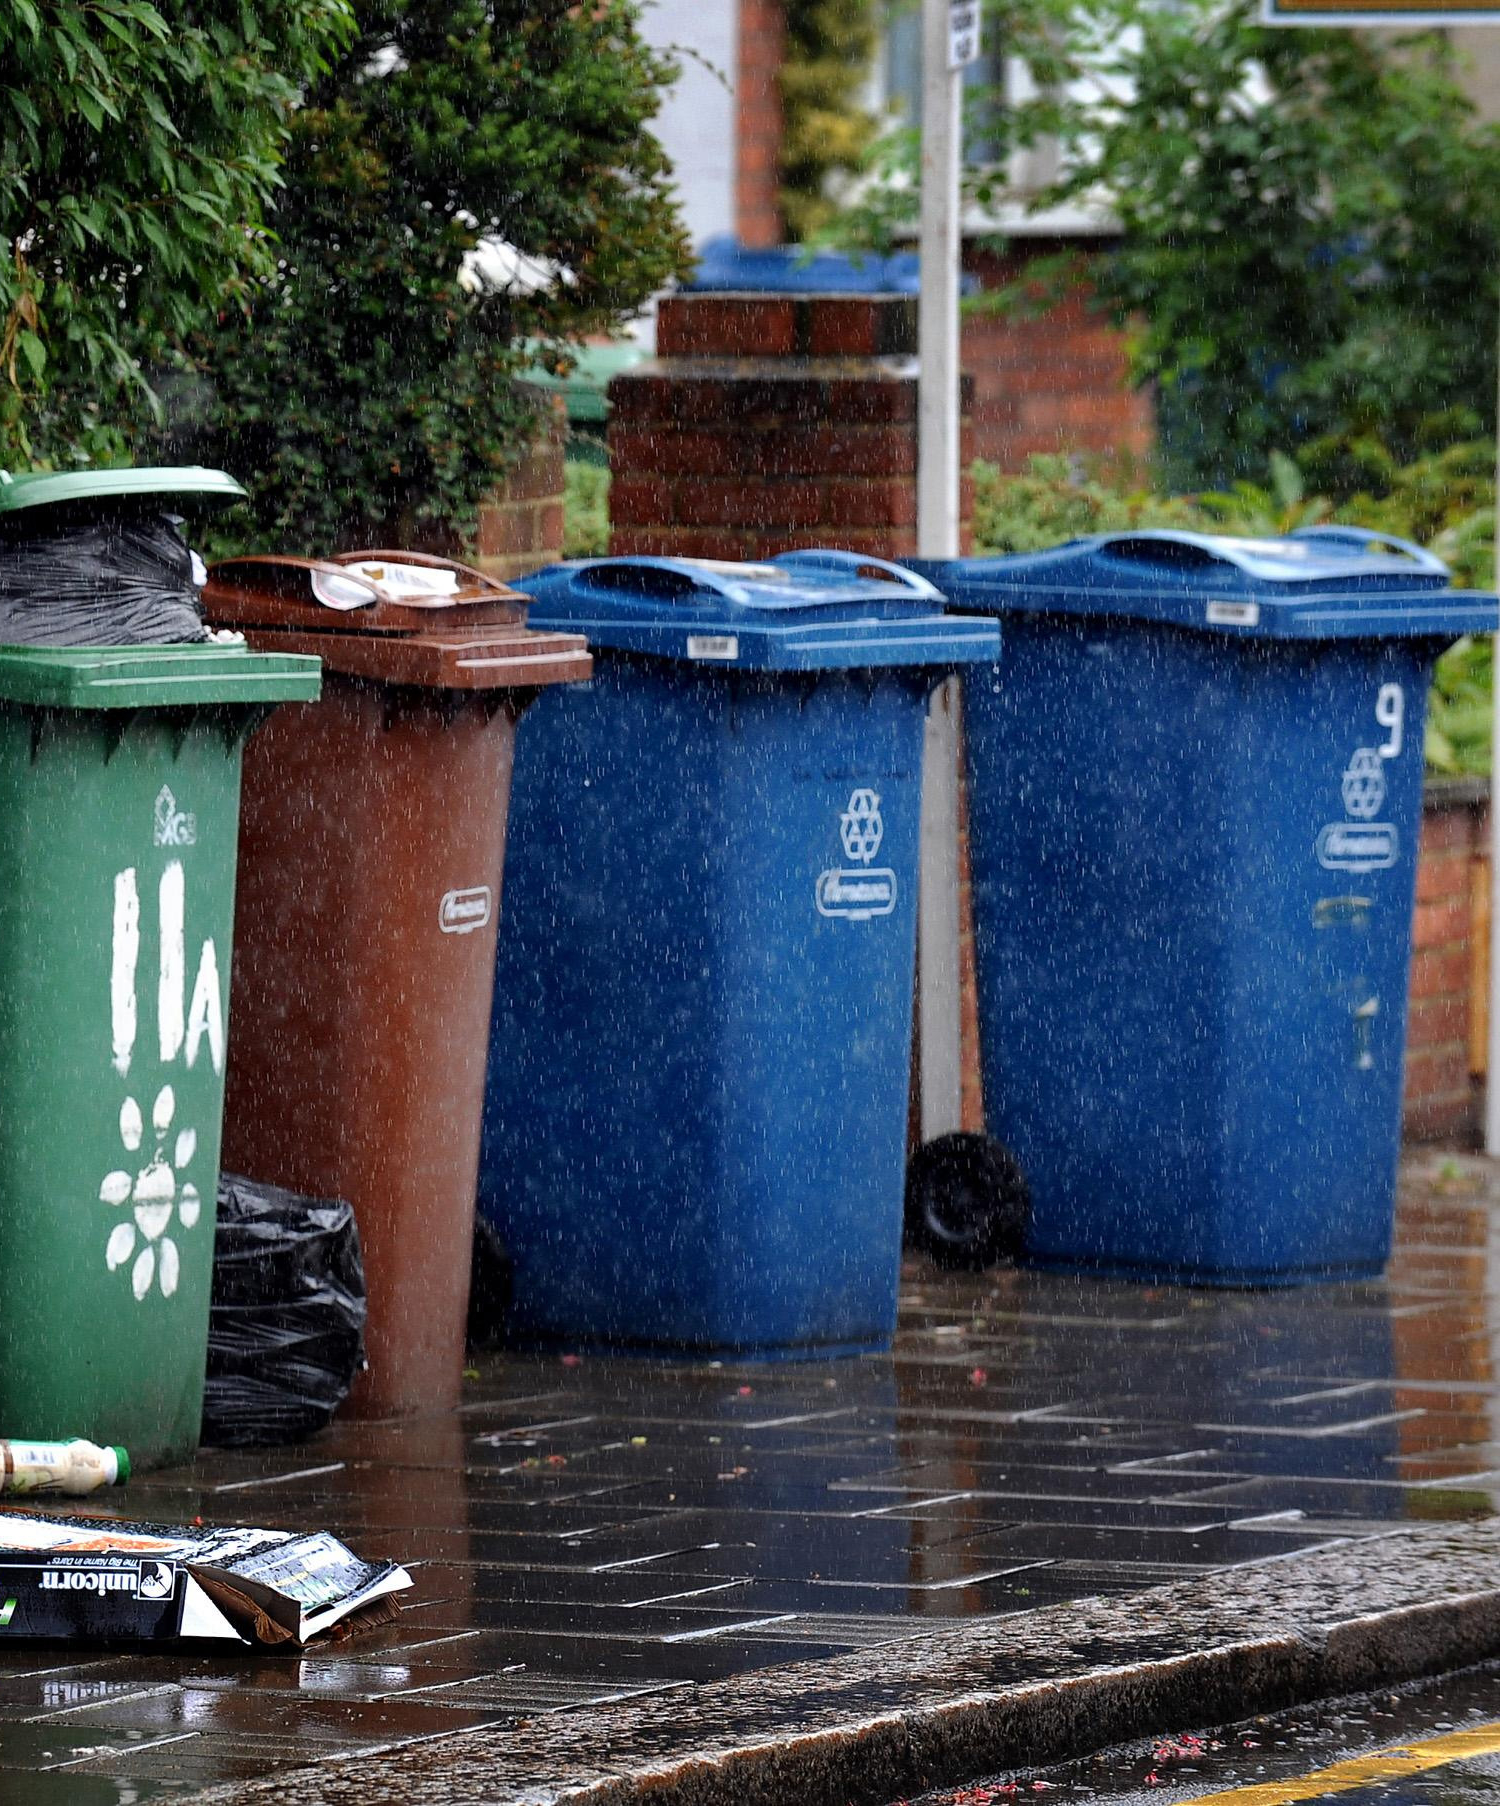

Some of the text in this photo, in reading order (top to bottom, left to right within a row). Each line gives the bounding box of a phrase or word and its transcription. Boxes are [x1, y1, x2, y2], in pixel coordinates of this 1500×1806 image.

[1375, 681, 1405, 758] 9
[51, 1557, 74, 1566] Darts
[83, 1557, 108, 1567] Name
[108, 1557, 123, 1567] Big
[42, 1571, 138, 1597] unicorn
